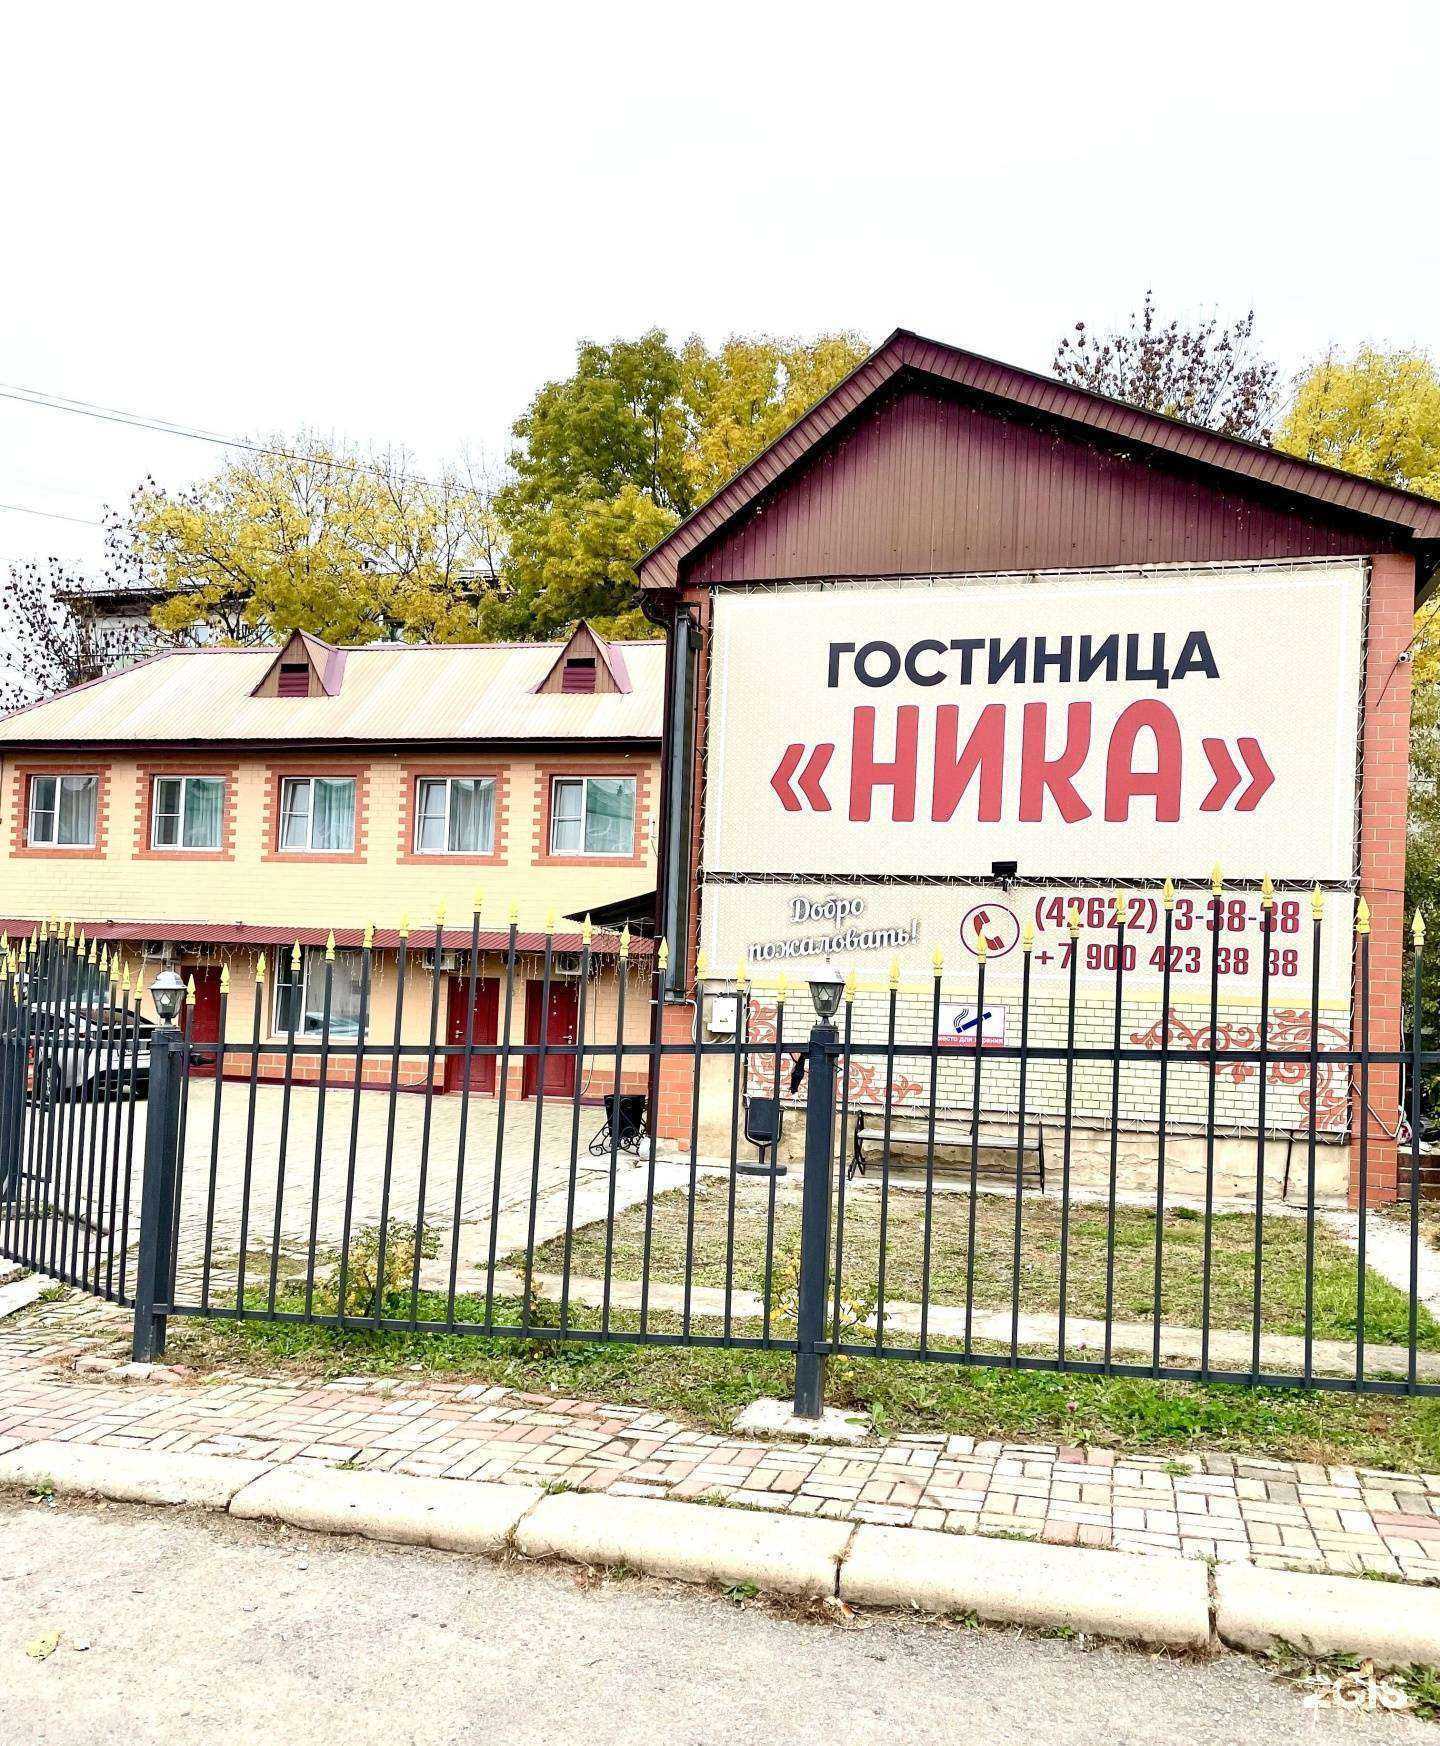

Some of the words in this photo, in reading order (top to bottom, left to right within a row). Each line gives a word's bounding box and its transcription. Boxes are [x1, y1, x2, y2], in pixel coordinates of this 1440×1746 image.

[827, 631, 1220, 689] ГОСТИНИЦА
[770, 699, 1275, 823] «НИКА»
[790, 895, 865, 929] Добро
[1035, 896, 1158, 933] (42622)
[1175, 899, 1300, 933] 3-38-38
[749, 919, 919, 961] пожаловать!
[1086, 943, 1137, 971] 900
[1149, 946, 1201, 973] 423
[1216, 947, 1249, 975] 38
[1266, 948, 1298, 977] 38
